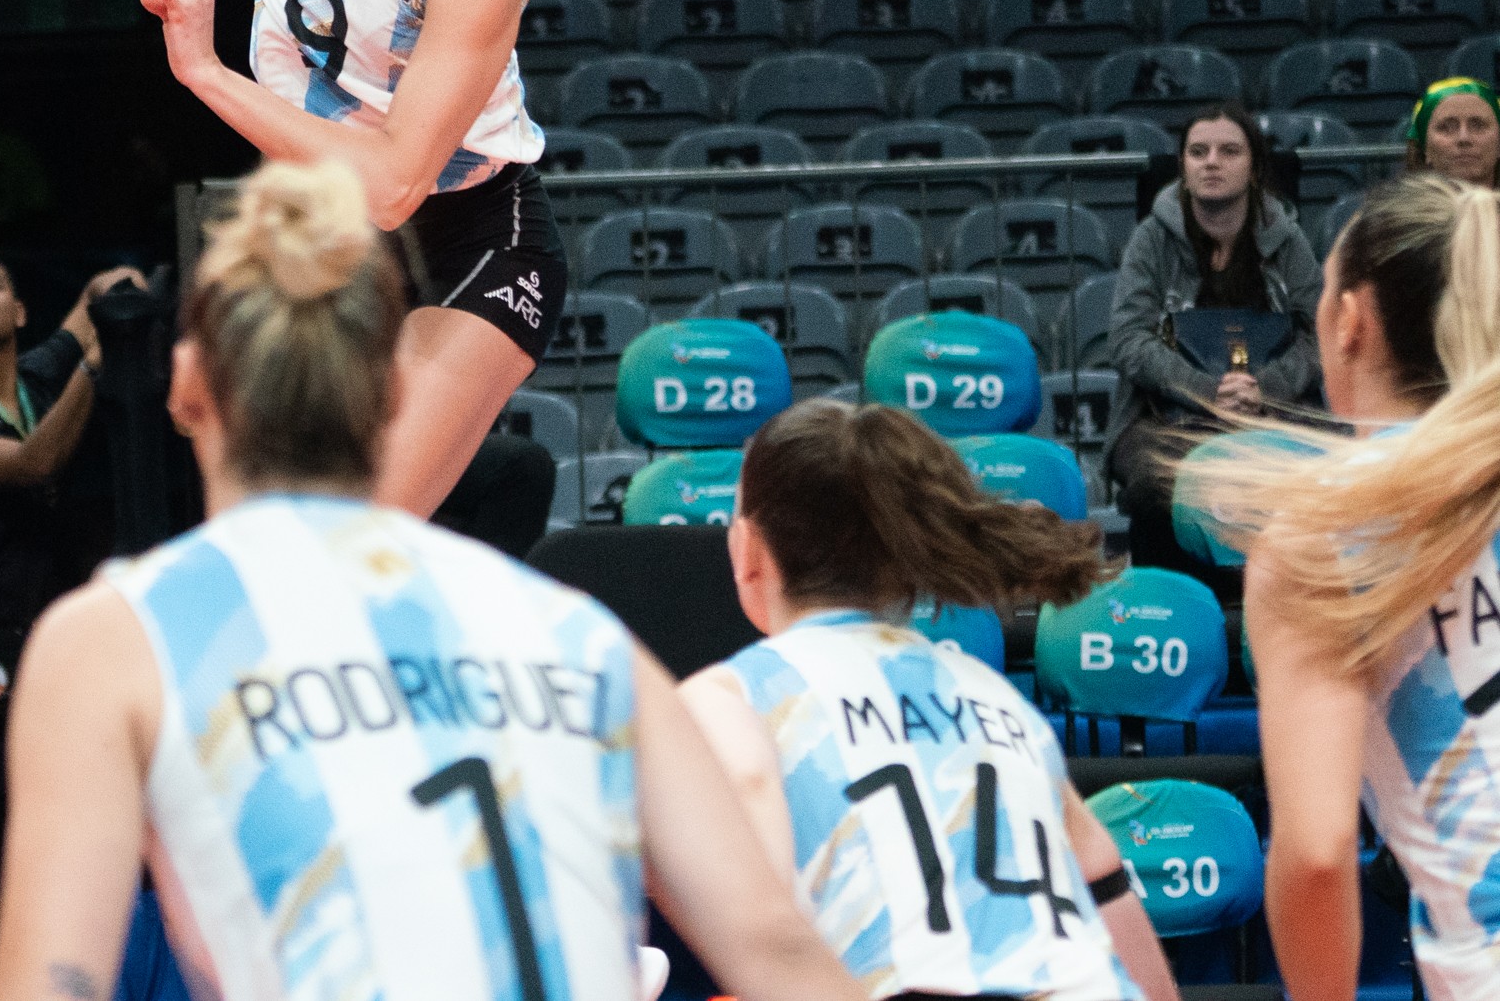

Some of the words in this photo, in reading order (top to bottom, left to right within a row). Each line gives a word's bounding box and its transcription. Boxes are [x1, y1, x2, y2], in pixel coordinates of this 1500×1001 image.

[484, 286, 543, 329] ARG
[653, 377, 688, 414] D
[704, 375, 757, 413] 28
[904, 372, 938, 411] D
[951, 373, 1005, 410] 29
[1429, 567, 1500, 658] FA
[1080, 631, 1115, 672] B
[1130, 634, 1189, 678] 30
[840, 691, 1040, 767] MAYER
[842, 762, 1082, 940] 14
[410, 756, 548, 1001] 1
[1161, 855, 1221, 899] 30
